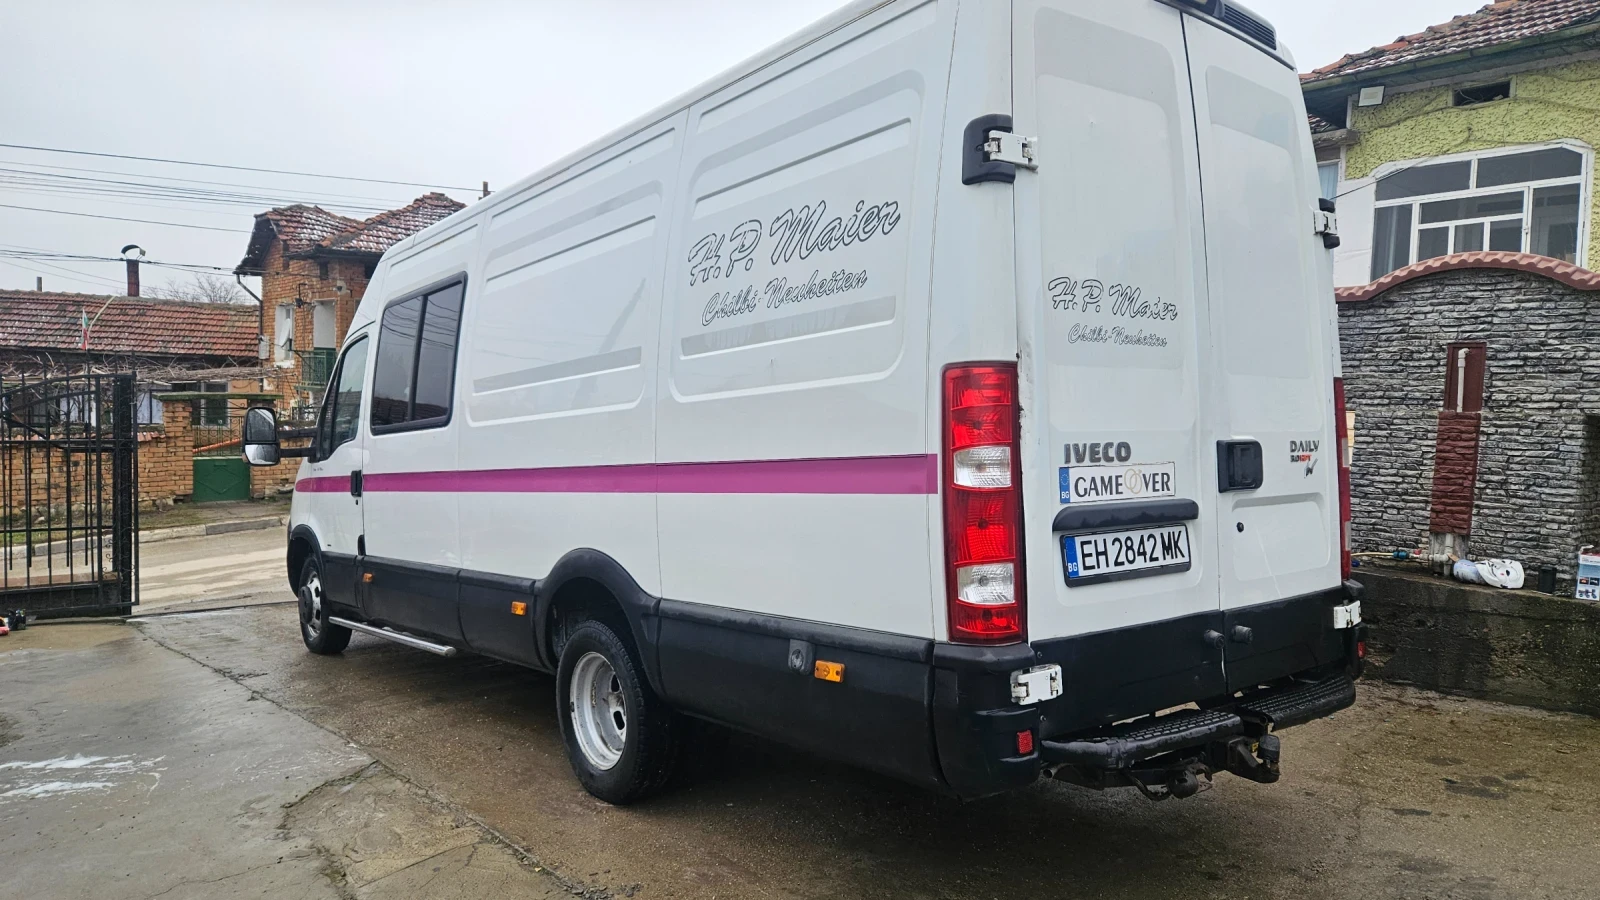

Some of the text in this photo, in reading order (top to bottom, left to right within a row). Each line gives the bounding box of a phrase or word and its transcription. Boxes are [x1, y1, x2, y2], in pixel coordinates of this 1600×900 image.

[769, 200, 901, 265] Maier
[1109, 283, 1178, 321] Maier
[1063, 441, 1132, 465] IVECO
[1290, 440, 1319, 453] DAILY
[1061, 491, 1070, 499] BG
[1074, 474, 1124, 498] GAME
[1068, 562, 1078, 572] BG
